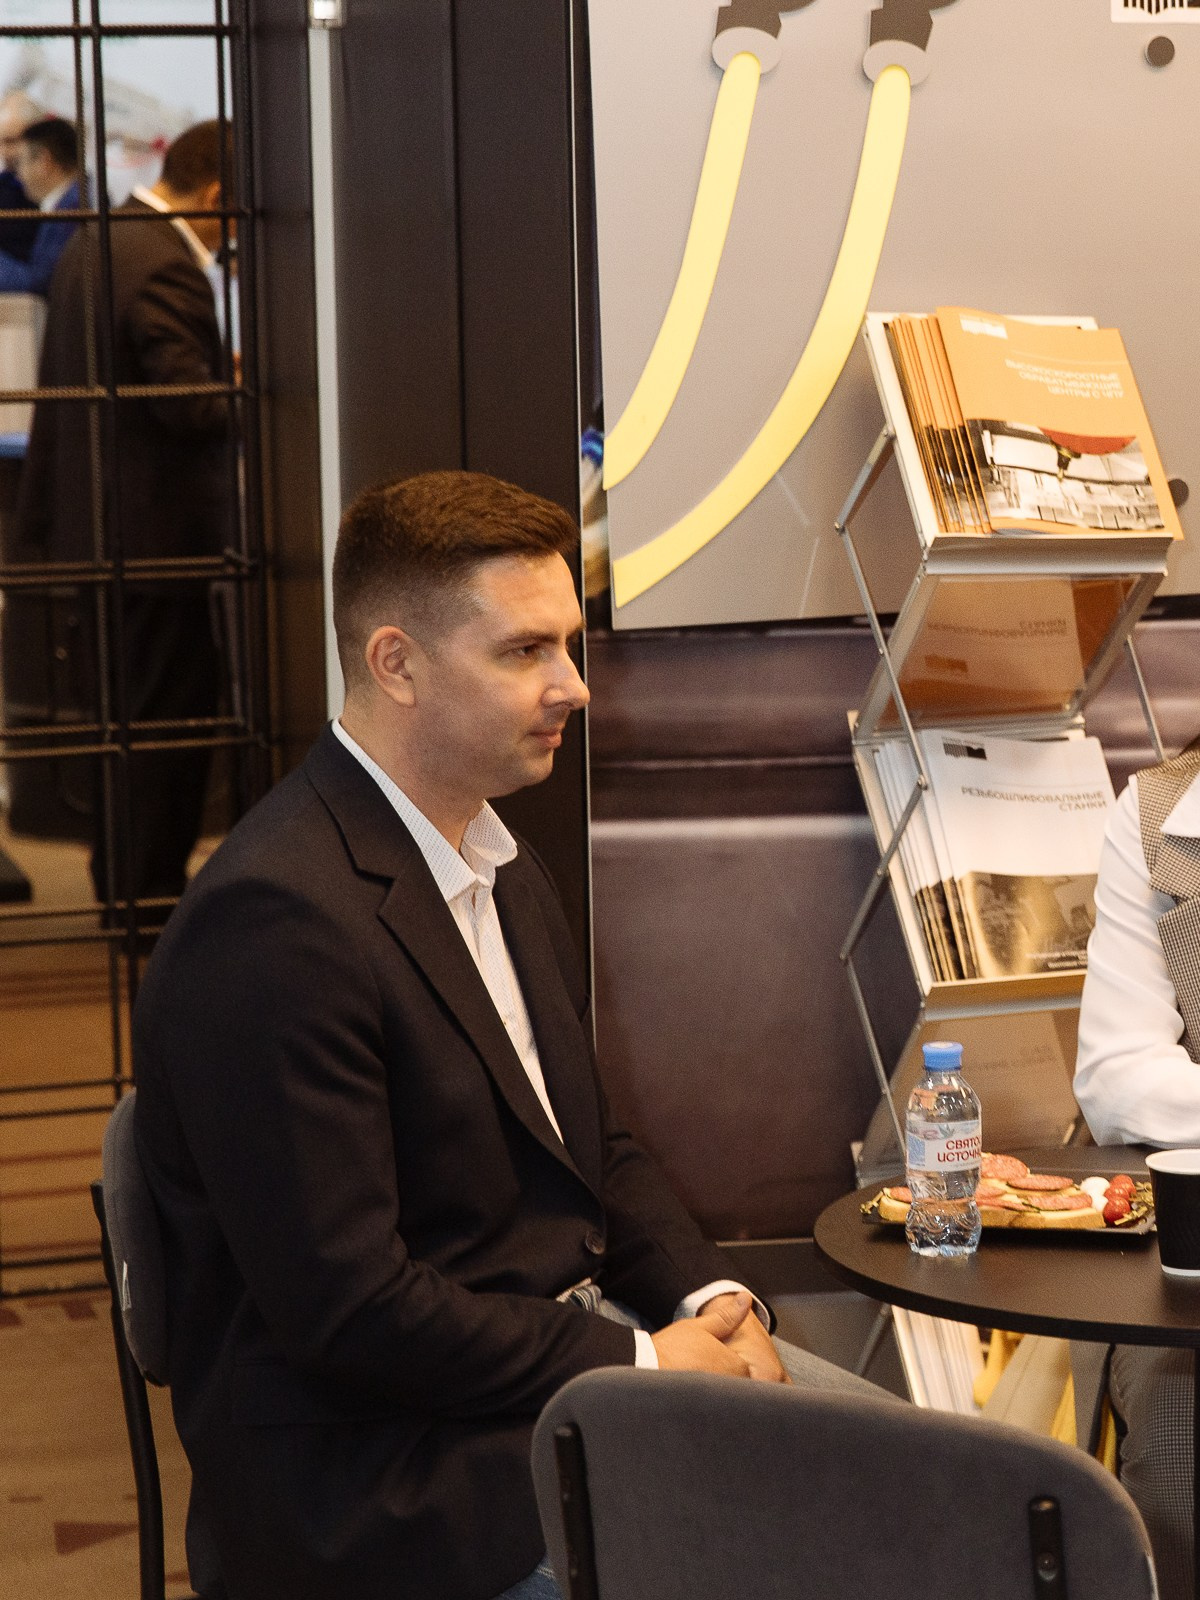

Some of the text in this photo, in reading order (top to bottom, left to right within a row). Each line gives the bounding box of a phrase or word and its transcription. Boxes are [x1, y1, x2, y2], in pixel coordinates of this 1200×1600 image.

[961, 786, 1104, 803] РЕЗЬБОШЛИФОВАЛЬНЫЕ
[1059, 801, 1107, 811] СТАНКИ
[945, 1136, 980, 1150] СВЯТО
[937, 1149, 980, 1162] ИСТОЧН
